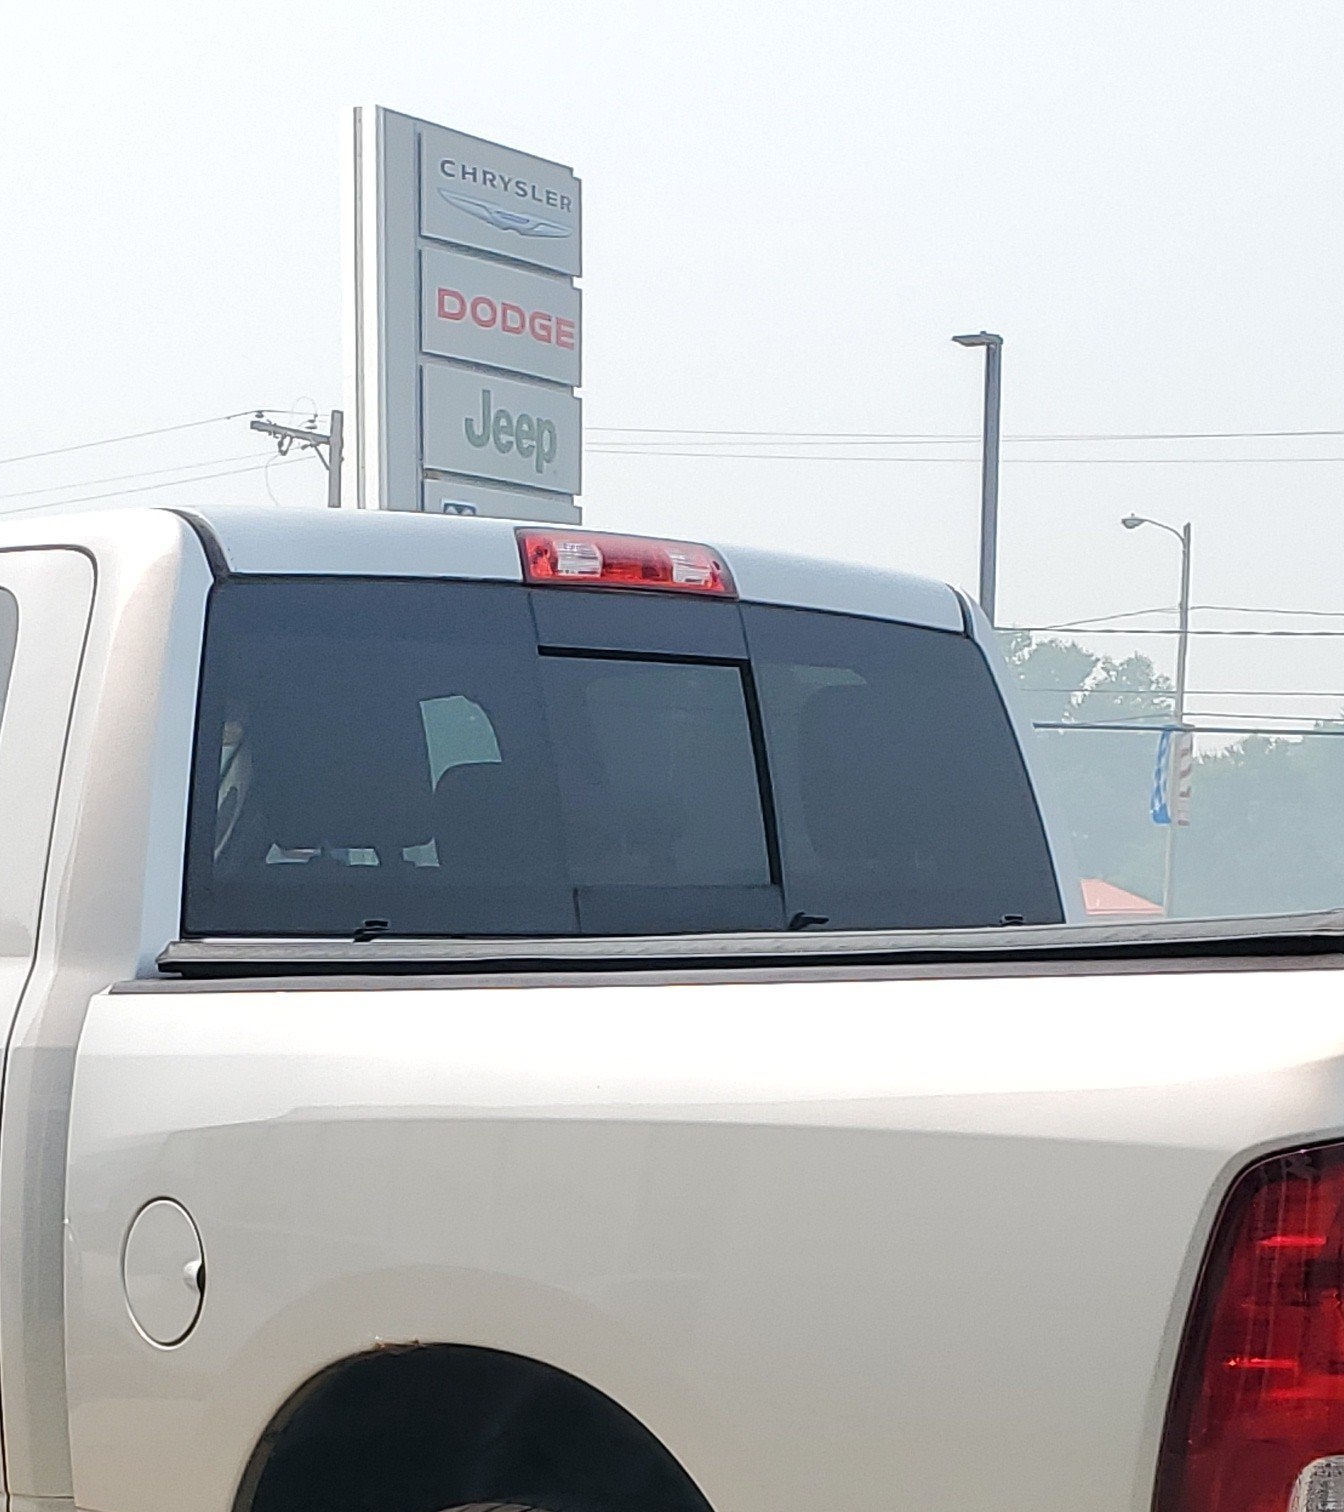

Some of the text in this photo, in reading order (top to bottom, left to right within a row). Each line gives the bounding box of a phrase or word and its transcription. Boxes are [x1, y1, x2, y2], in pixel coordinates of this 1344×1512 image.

[440, 158, 573, 213] CHRYSLER
[436, 287, 576, 350] DODGE
[464, 389, 557, 473] Jeep
